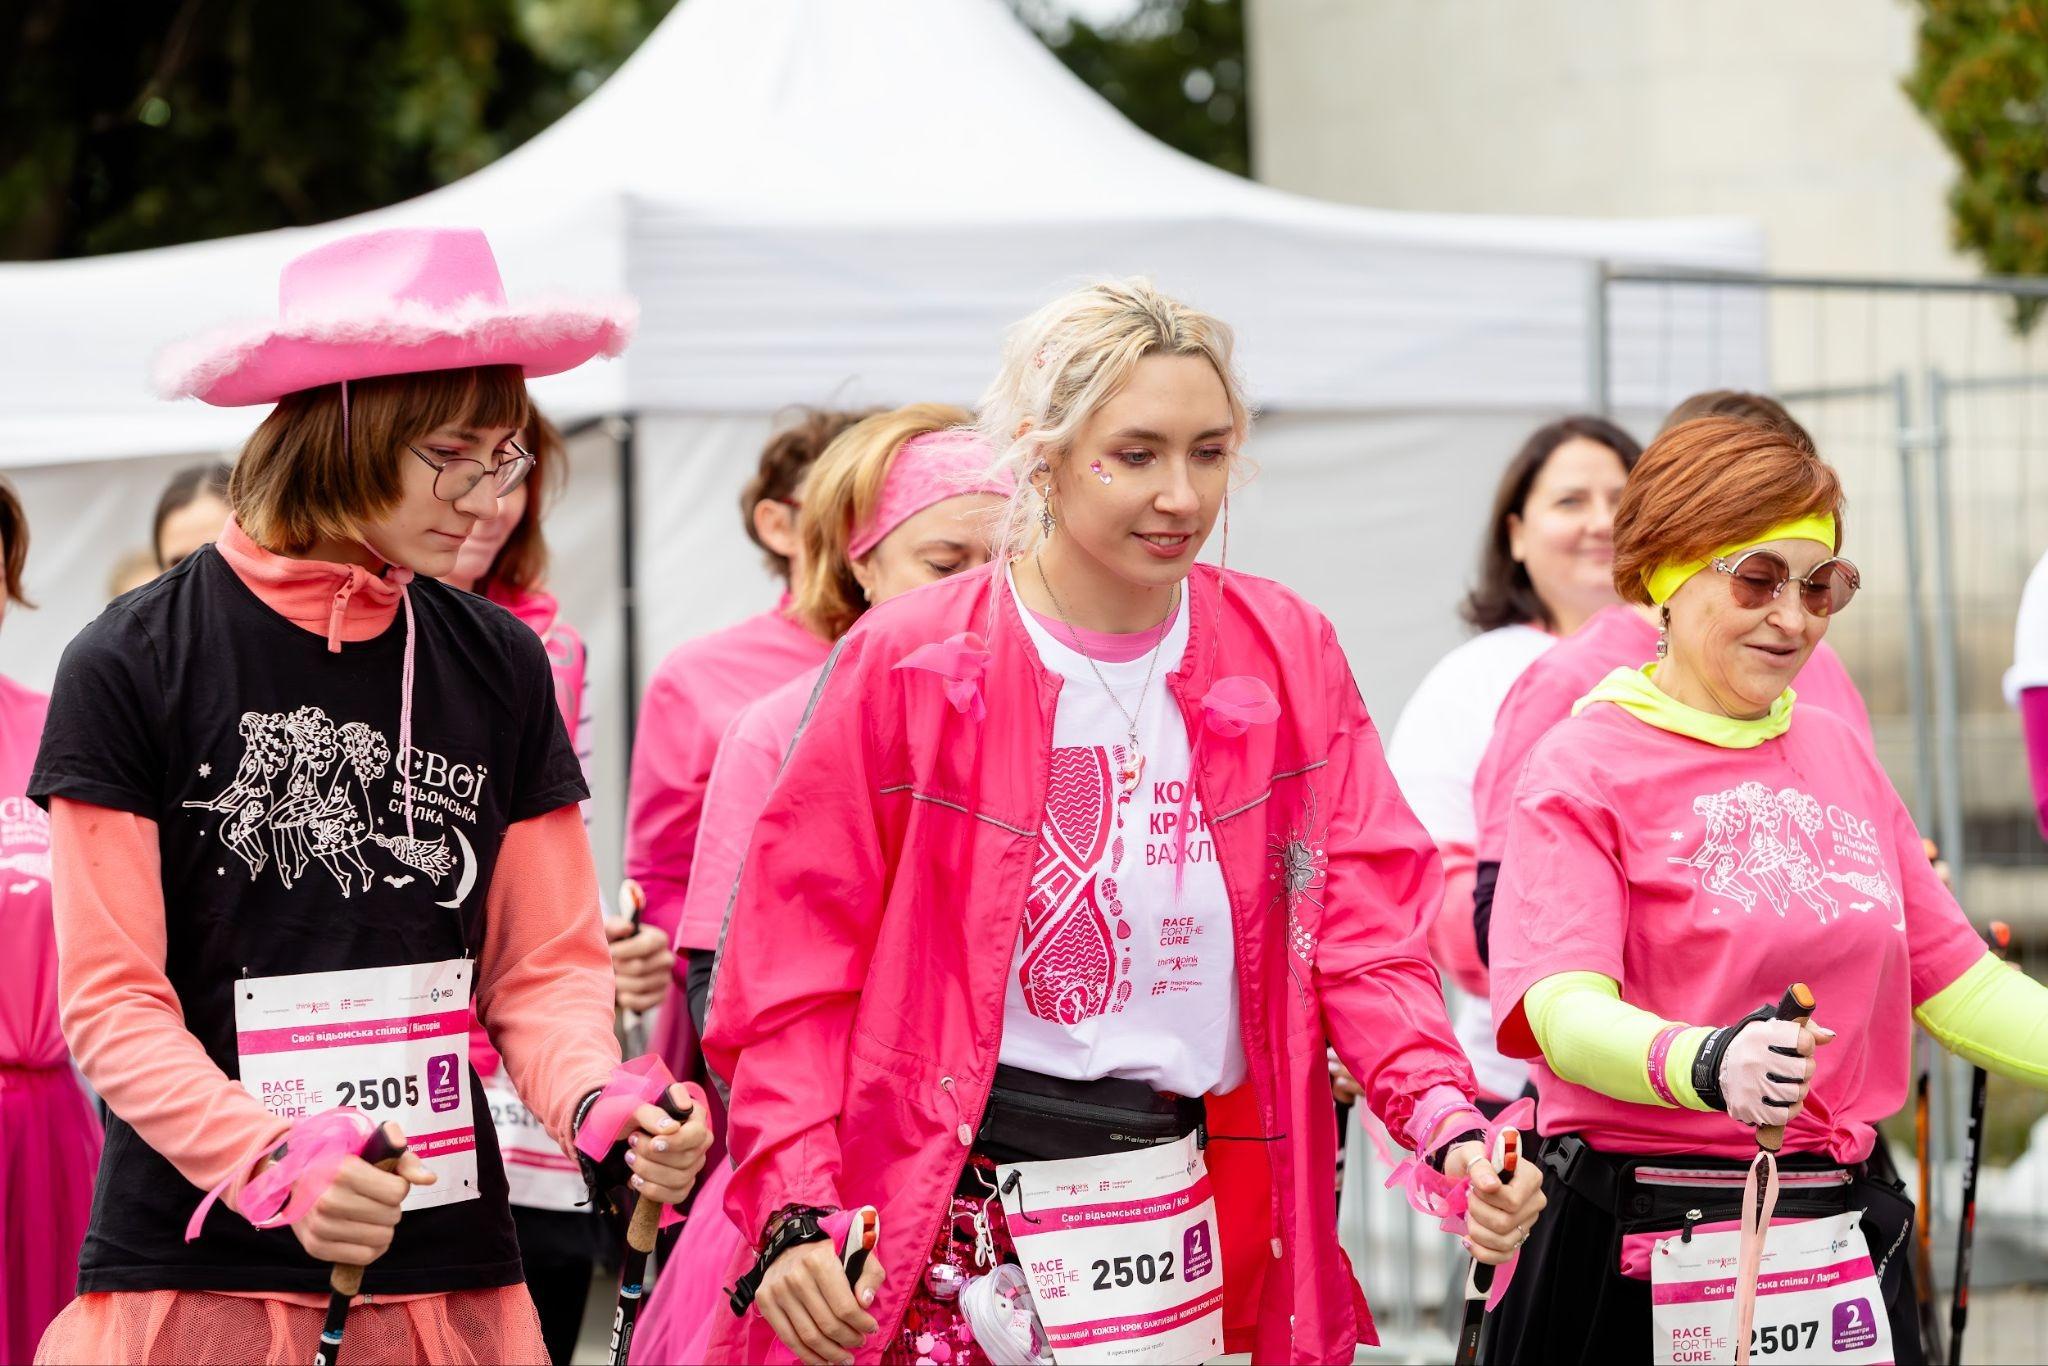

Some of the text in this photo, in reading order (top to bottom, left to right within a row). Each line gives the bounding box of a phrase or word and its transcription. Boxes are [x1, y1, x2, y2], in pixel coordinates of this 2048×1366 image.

[1163, 917, 1194, 927] RACE
[1161, 926, 1204, 936] FOR THE
[1160, 936, 1190, 946] CURE
[291, 1031, 315, 1043] Свої
[375, 1025, 407, 1036] спілка
[439, 1060, 450, 1085] 2
[261, 1079, 305, 1093] RACE
[336, 1075, 419, 1110] 2505
[263, 1091, 323, 1107] FOR THE
[1061, 1212, 1083, 1223] Свої
[1085, 1208, 1140, 1220] відьомська
[1143, 1202, 1171, 1214] спілка
[1192, 1229, 1203, 1255] 2
[1031, 1258, 1063, 1272] RACE
[1092, 1251, 1175, 1291] 2502
[1035, 1270, 1080, 1287] FOR THE
[1704, 1284, 1725, 1295] Свої
[1780, 1276, 1808, 1287] спілка
[1092, 1326, 1119, 1336] КОЖЕН
[1121, 1322, 1142, 1333] КРОК
[1143, 1312, 1178, 1328] ВАЖЛИВИЙ
[1846, 1304, 1863, 1329] 2
[1673, 1327, 1711, 1339] RACE
[1673, 1337, 1727, 1351] FOR THE
